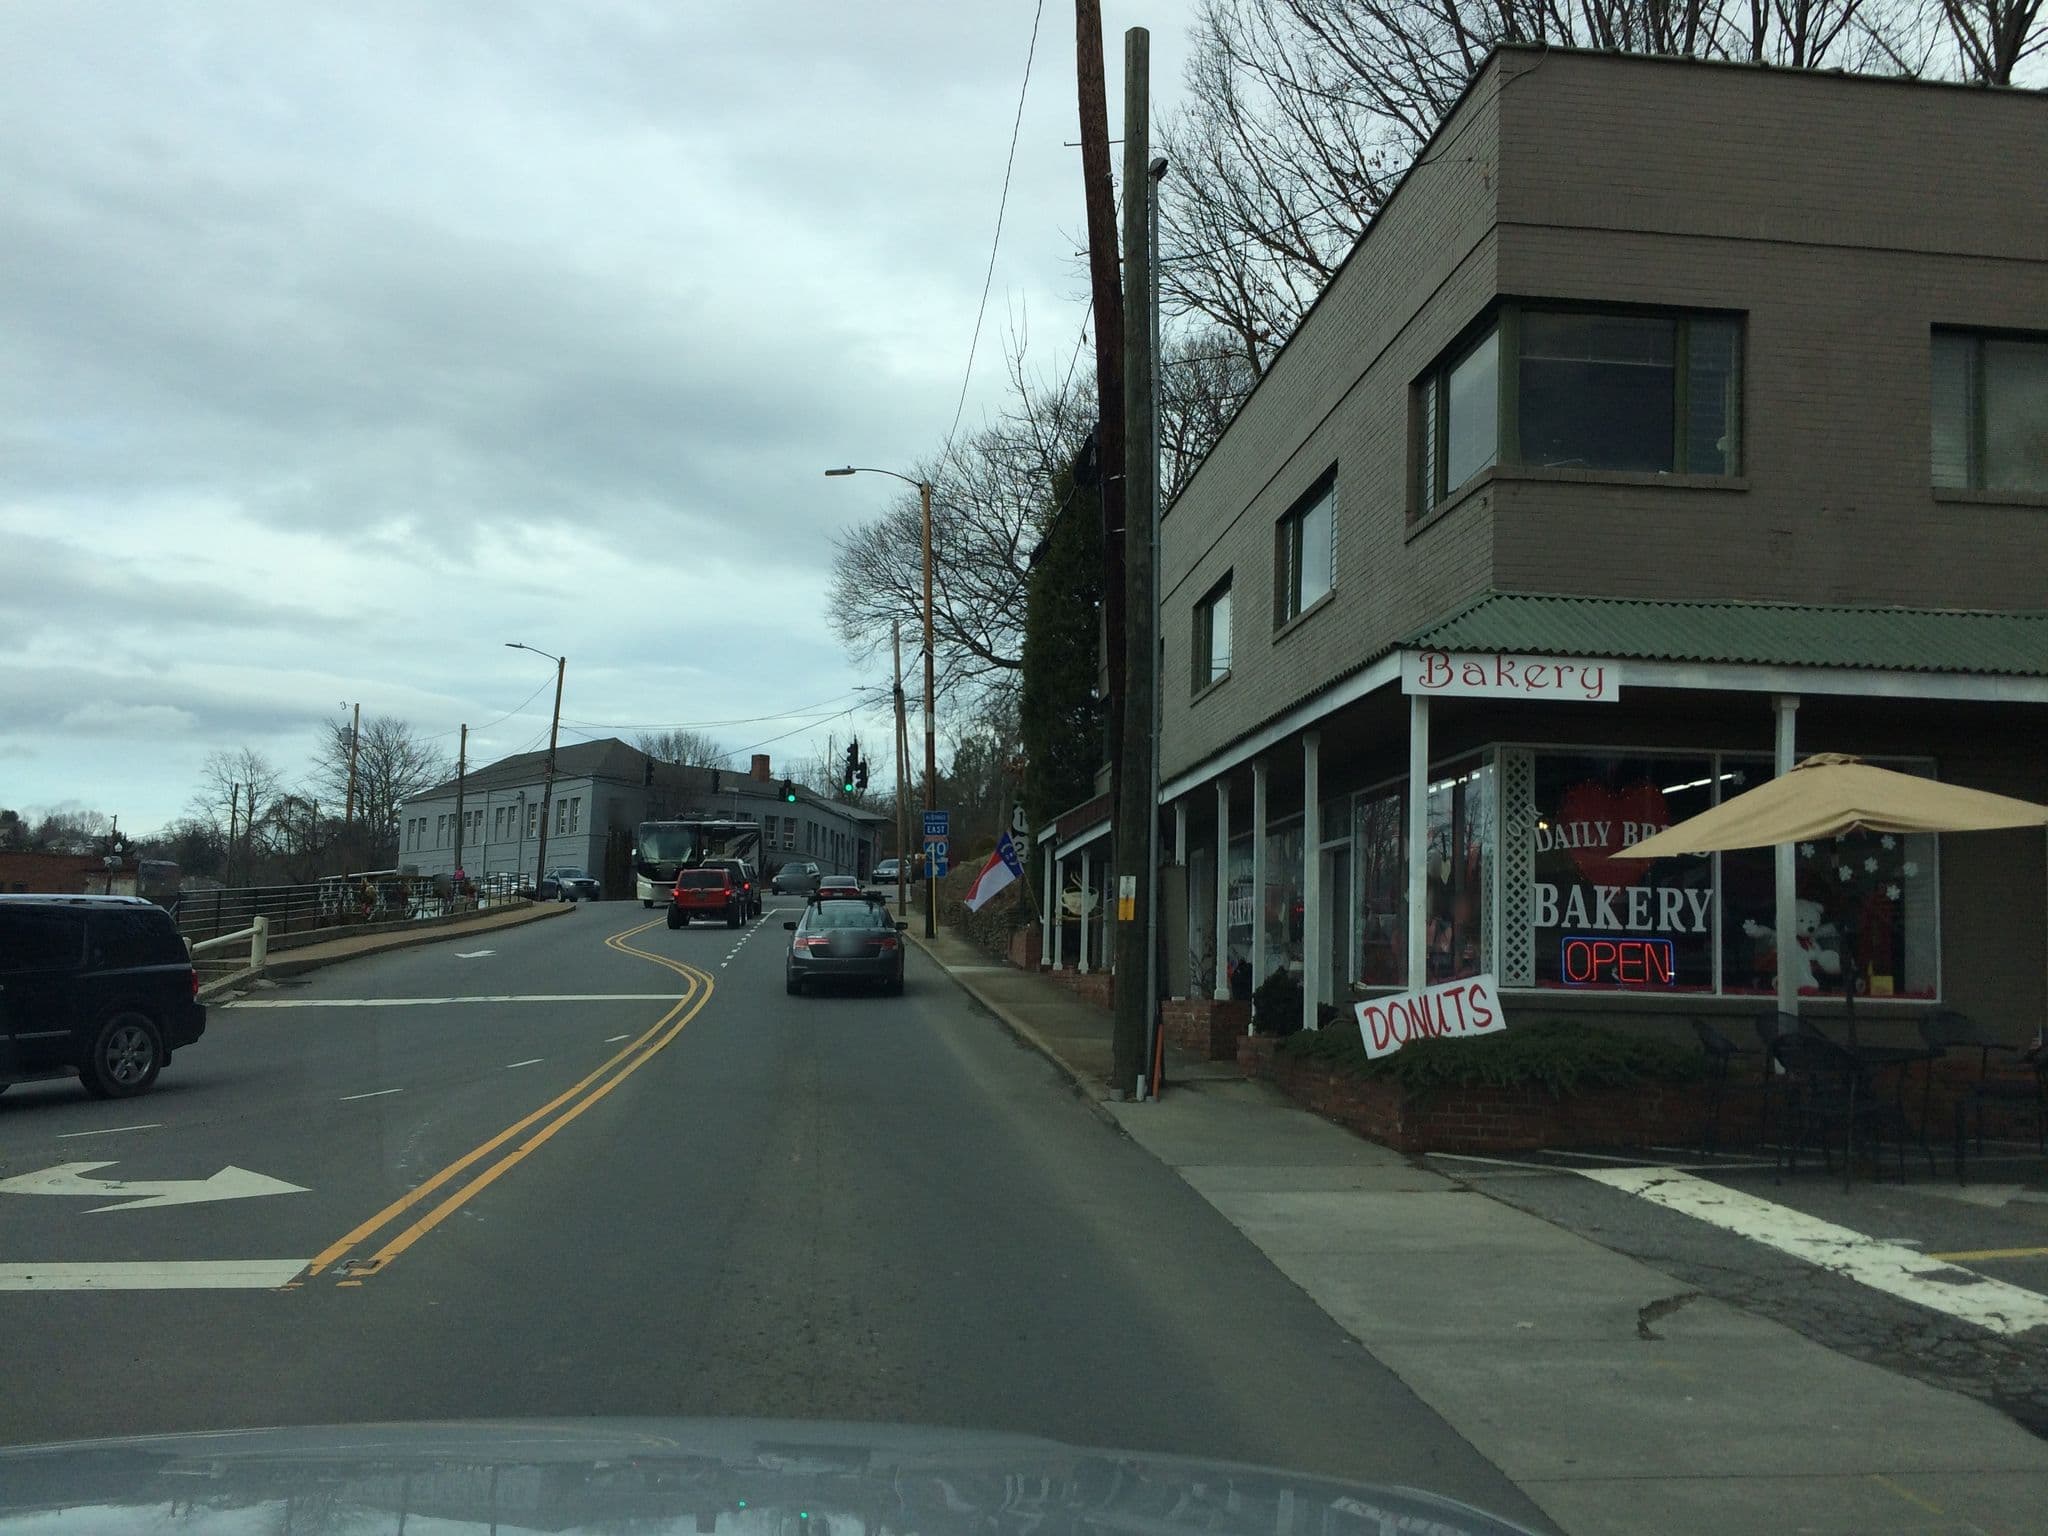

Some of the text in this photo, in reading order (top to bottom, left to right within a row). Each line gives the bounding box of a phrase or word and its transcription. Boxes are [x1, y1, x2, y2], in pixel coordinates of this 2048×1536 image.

[1418, 651, 1604, 699] Bakery
[926, 842, 946, 856] 40
[927, 825, 945, 835] EAST
[1506, 803, 1544, 837] OUR
[1532, 821, 1611, 853] DAILY
[1532, 882, 1714, 933] BAKERY
[1567, 941, 1670, 984] OPEN
[1363, 983, 1493, 1051] DONUTS
